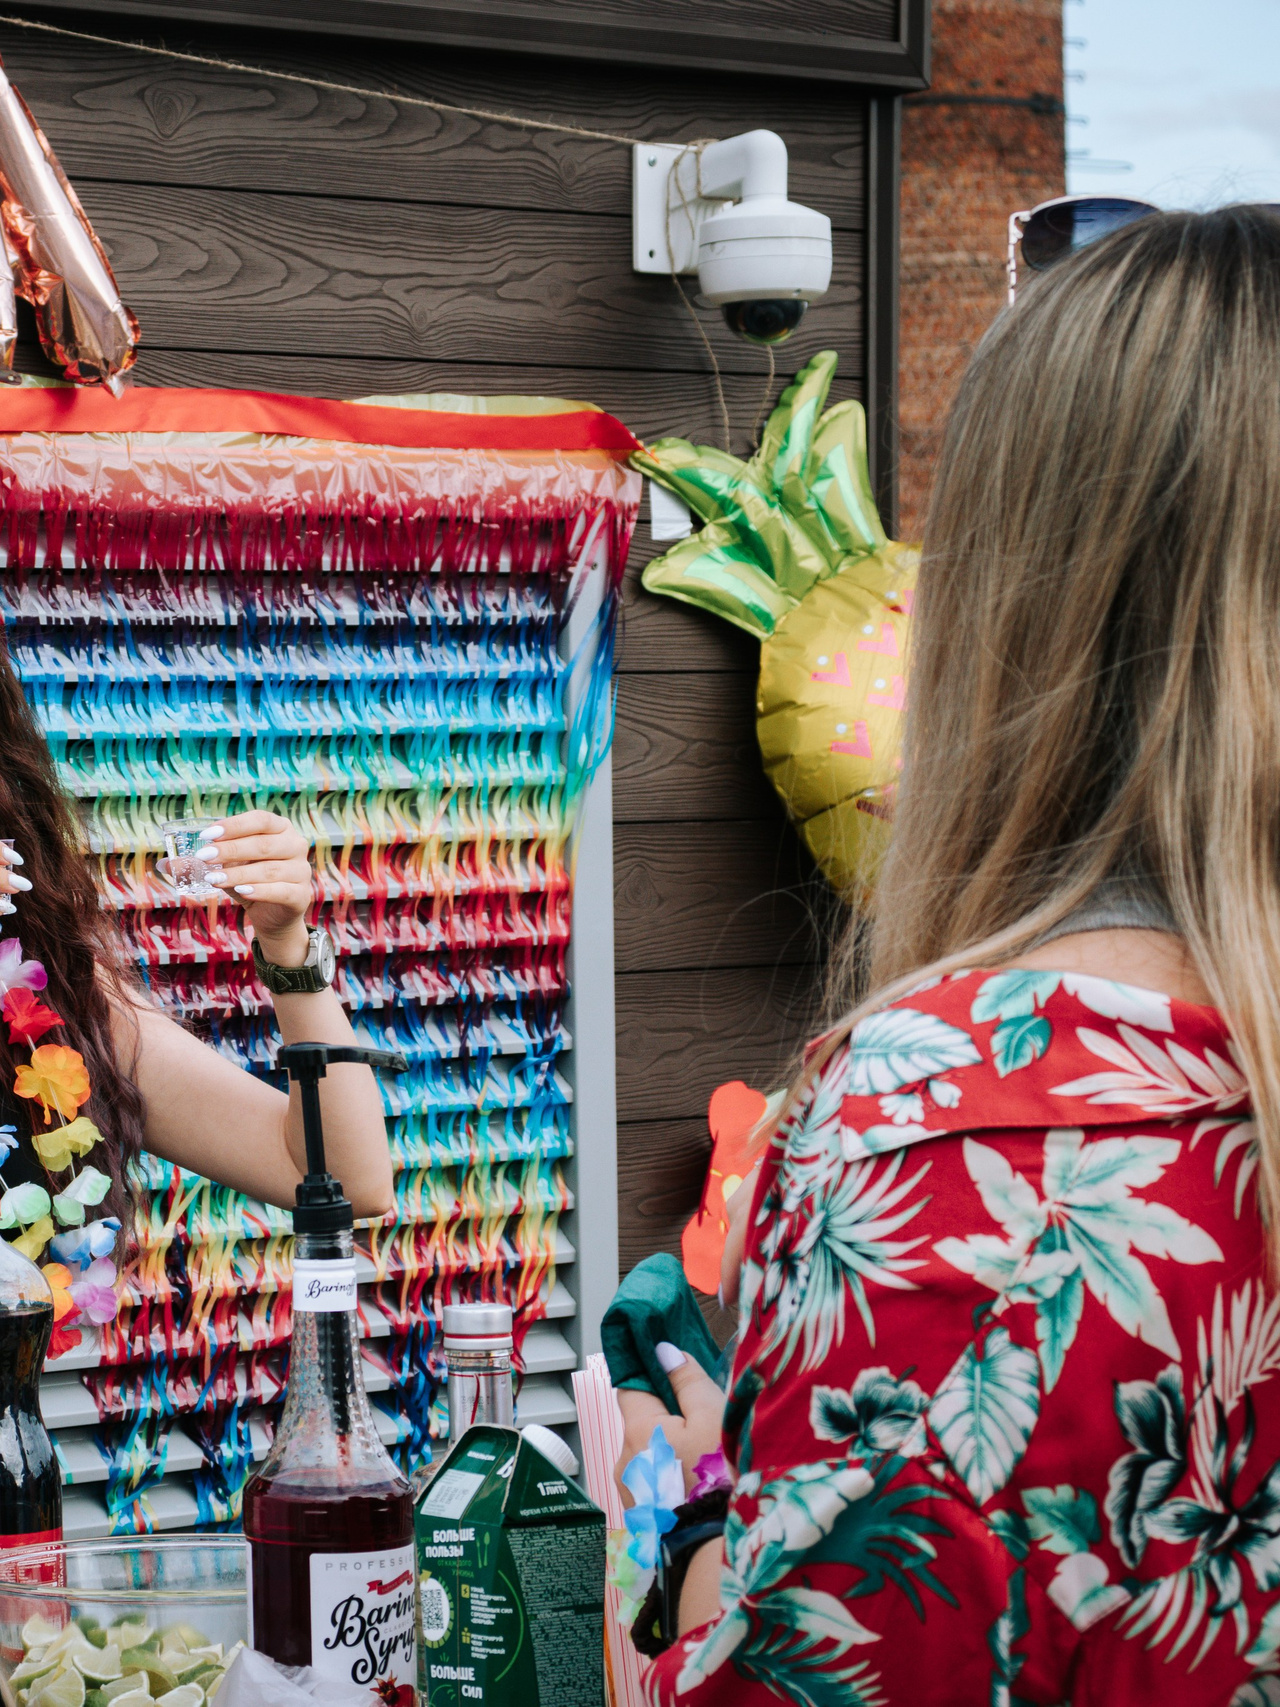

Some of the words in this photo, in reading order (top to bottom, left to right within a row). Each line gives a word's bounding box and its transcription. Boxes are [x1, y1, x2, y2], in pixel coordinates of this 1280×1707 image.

[546, 1485, 568, 1496] ЛИТР
[433, 1527, 475, 1543] БОЛЬШЕ
[425, 1545, 464, 1558] ПОЛЬЗЫ
[430, 1664, 475, 1681] БОЛЬШЕ
[461, 1684, 483, 1699] СИЛ
